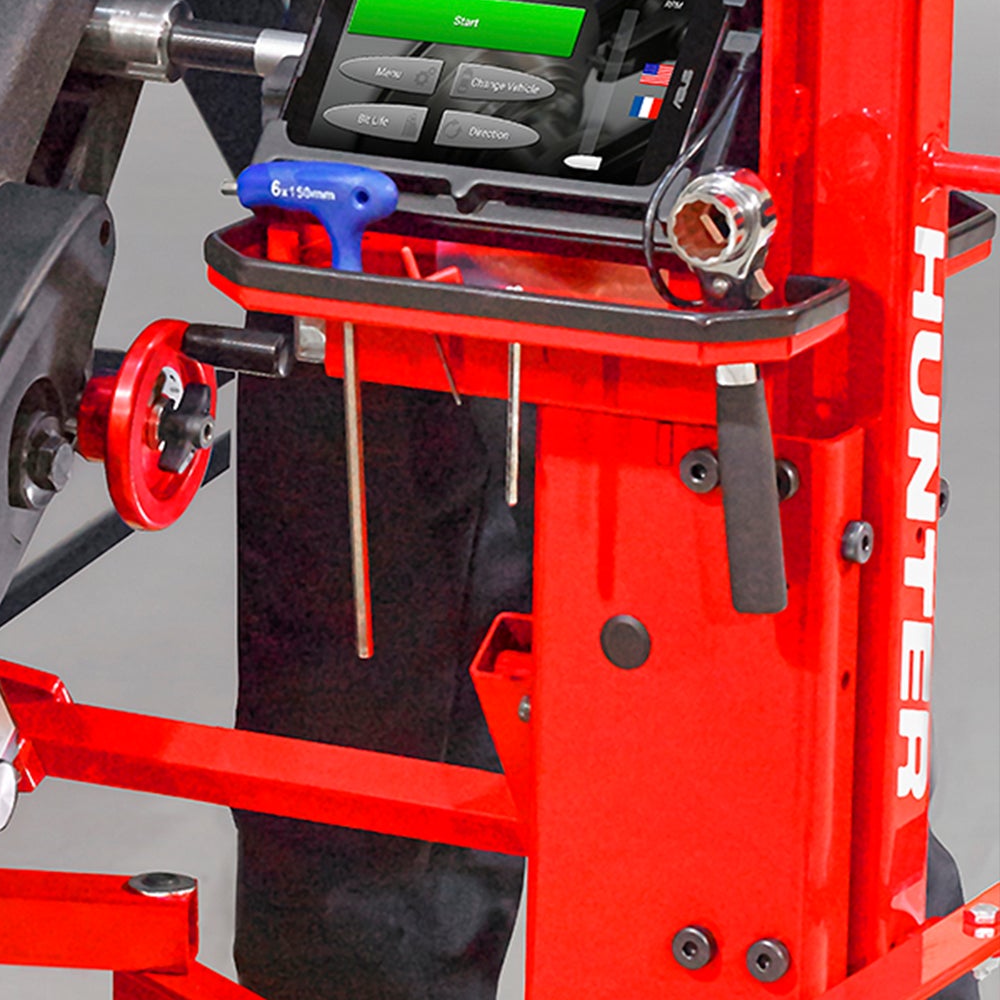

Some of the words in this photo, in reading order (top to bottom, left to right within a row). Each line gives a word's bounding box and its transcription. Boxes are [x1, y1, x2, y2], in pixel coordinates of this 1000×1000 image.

[663, 0, 684, 10] RPM
[453, 15, 480, 28] Start
[375, 66, 402, 80] Menu
[471, 77, 506, 93] Change
[507, 82, 541, 95] Vehicle
[468, 126, 510, 140] Direction
[270, 179, 336, 201] 6x150mm
[897, 225, 945, 800] HUNTER
